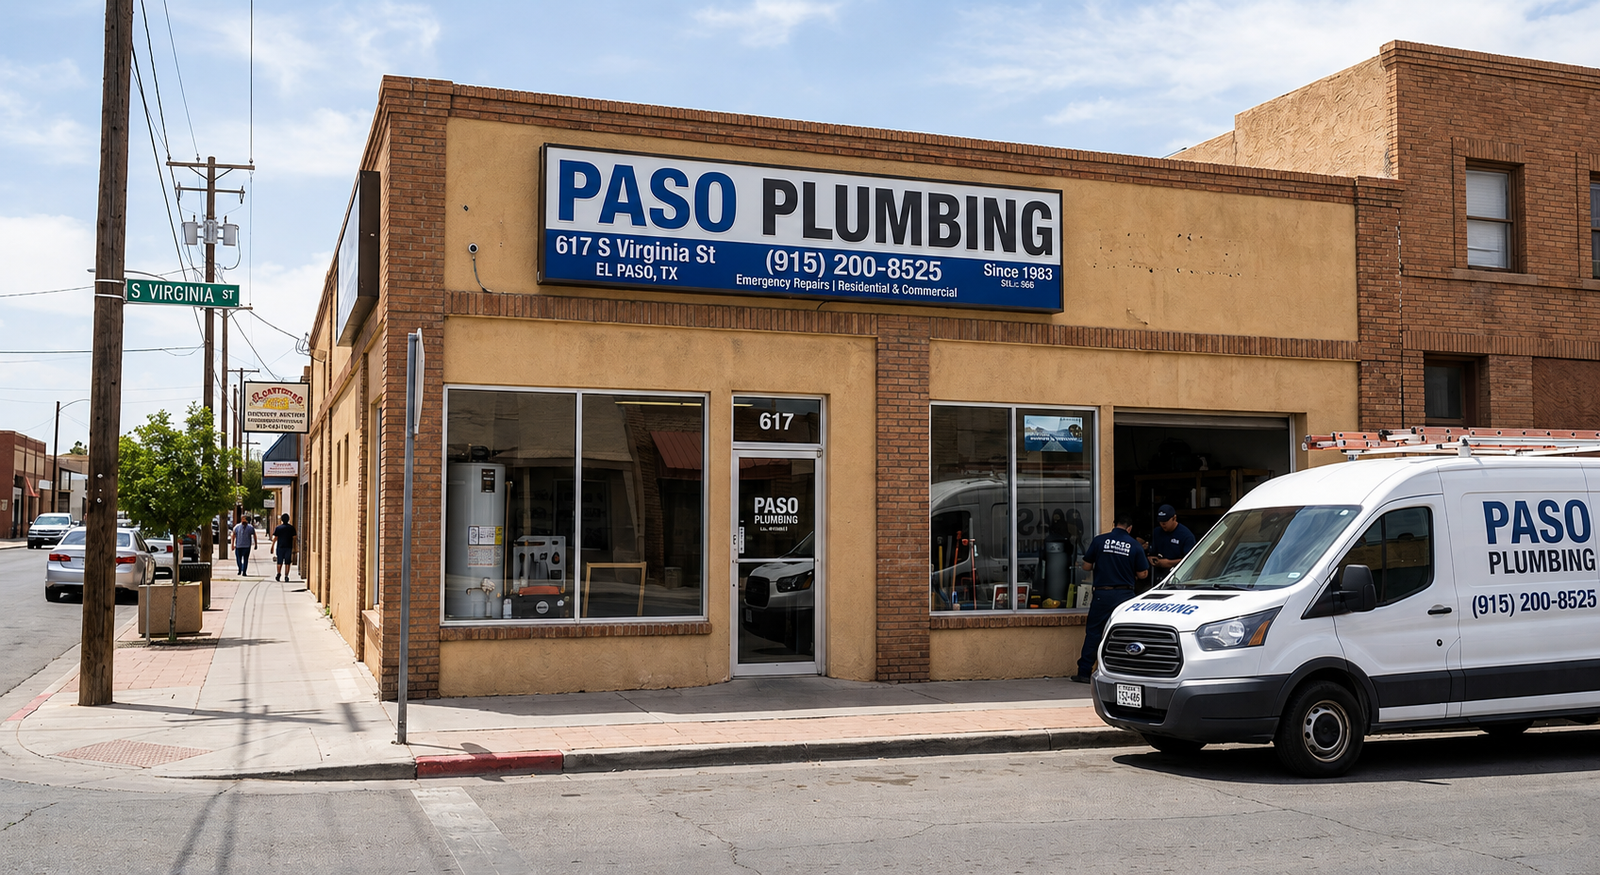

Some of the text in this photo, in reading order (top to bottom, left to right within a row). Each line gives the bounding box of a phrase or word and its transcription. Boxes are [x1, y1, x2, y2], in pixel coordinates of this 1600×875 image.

[557, 159, 1053, 257] PASO PLUMBING
[555, 235, 716, 265] 617 S Virginia St
[595, 262, 678, 282] EL PASO, TX
[765, 248, 942, 282] (915) 200-8525
[983, 263, 1053, 281] Since 1983
[131, 283, 235, 303] S VIRGINIA ST
[736, 273, 791, 291] Emergency
[793, 277, 830, 292] Repairs
[837, 280, 890, 294] Residential
[891, 283, 900, 294] &
[901, 283, 958, 298] Commercial
[759, 412, 794, 431] 617
[754, 497, 799, 514] PASO
[754, 515, 799, 525] PLUMBING
[1482, 499, 1592, 545] PASO
[1488, 547, 1596, 575] PLUMBING
[1124, 602, 1200, 616] PLUMBING
[1471, 589, 1597, 619] (915) 200-8525
